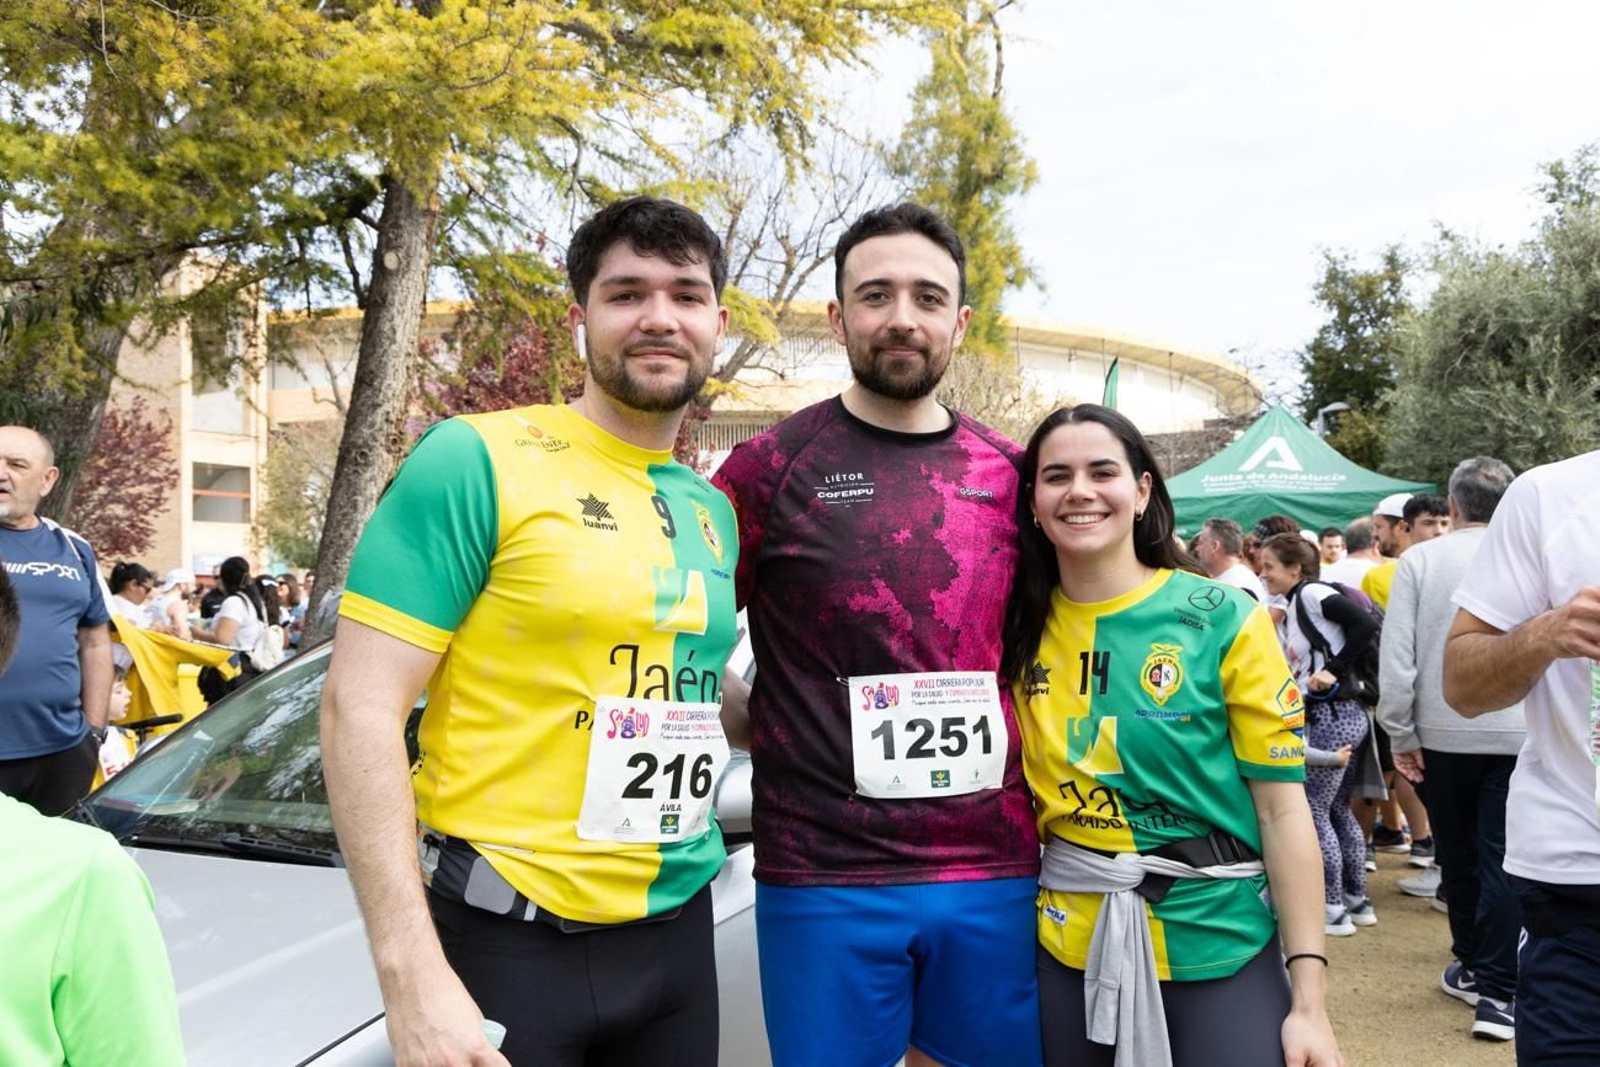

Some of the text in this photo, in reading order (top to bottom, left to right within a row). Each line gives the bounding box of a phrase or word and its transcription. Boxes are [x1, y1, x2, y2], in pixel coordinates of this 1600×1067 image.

[817, 488, 874, 498] COFERPU
[825, 472, 864, 484] LIÉTOR
[1201, 474, 1243, 483] Junta
[1247, 472, 1266, 480] de
[583, 517, 618, 532] luanvi
[651, 496, 677, 539] 9
[610, 644, 722, 704] Jaén
[1079, 651, 1110, 695] 14
[871, 715, 992, 760] 1251
[621, 752, 713, 800] 216
